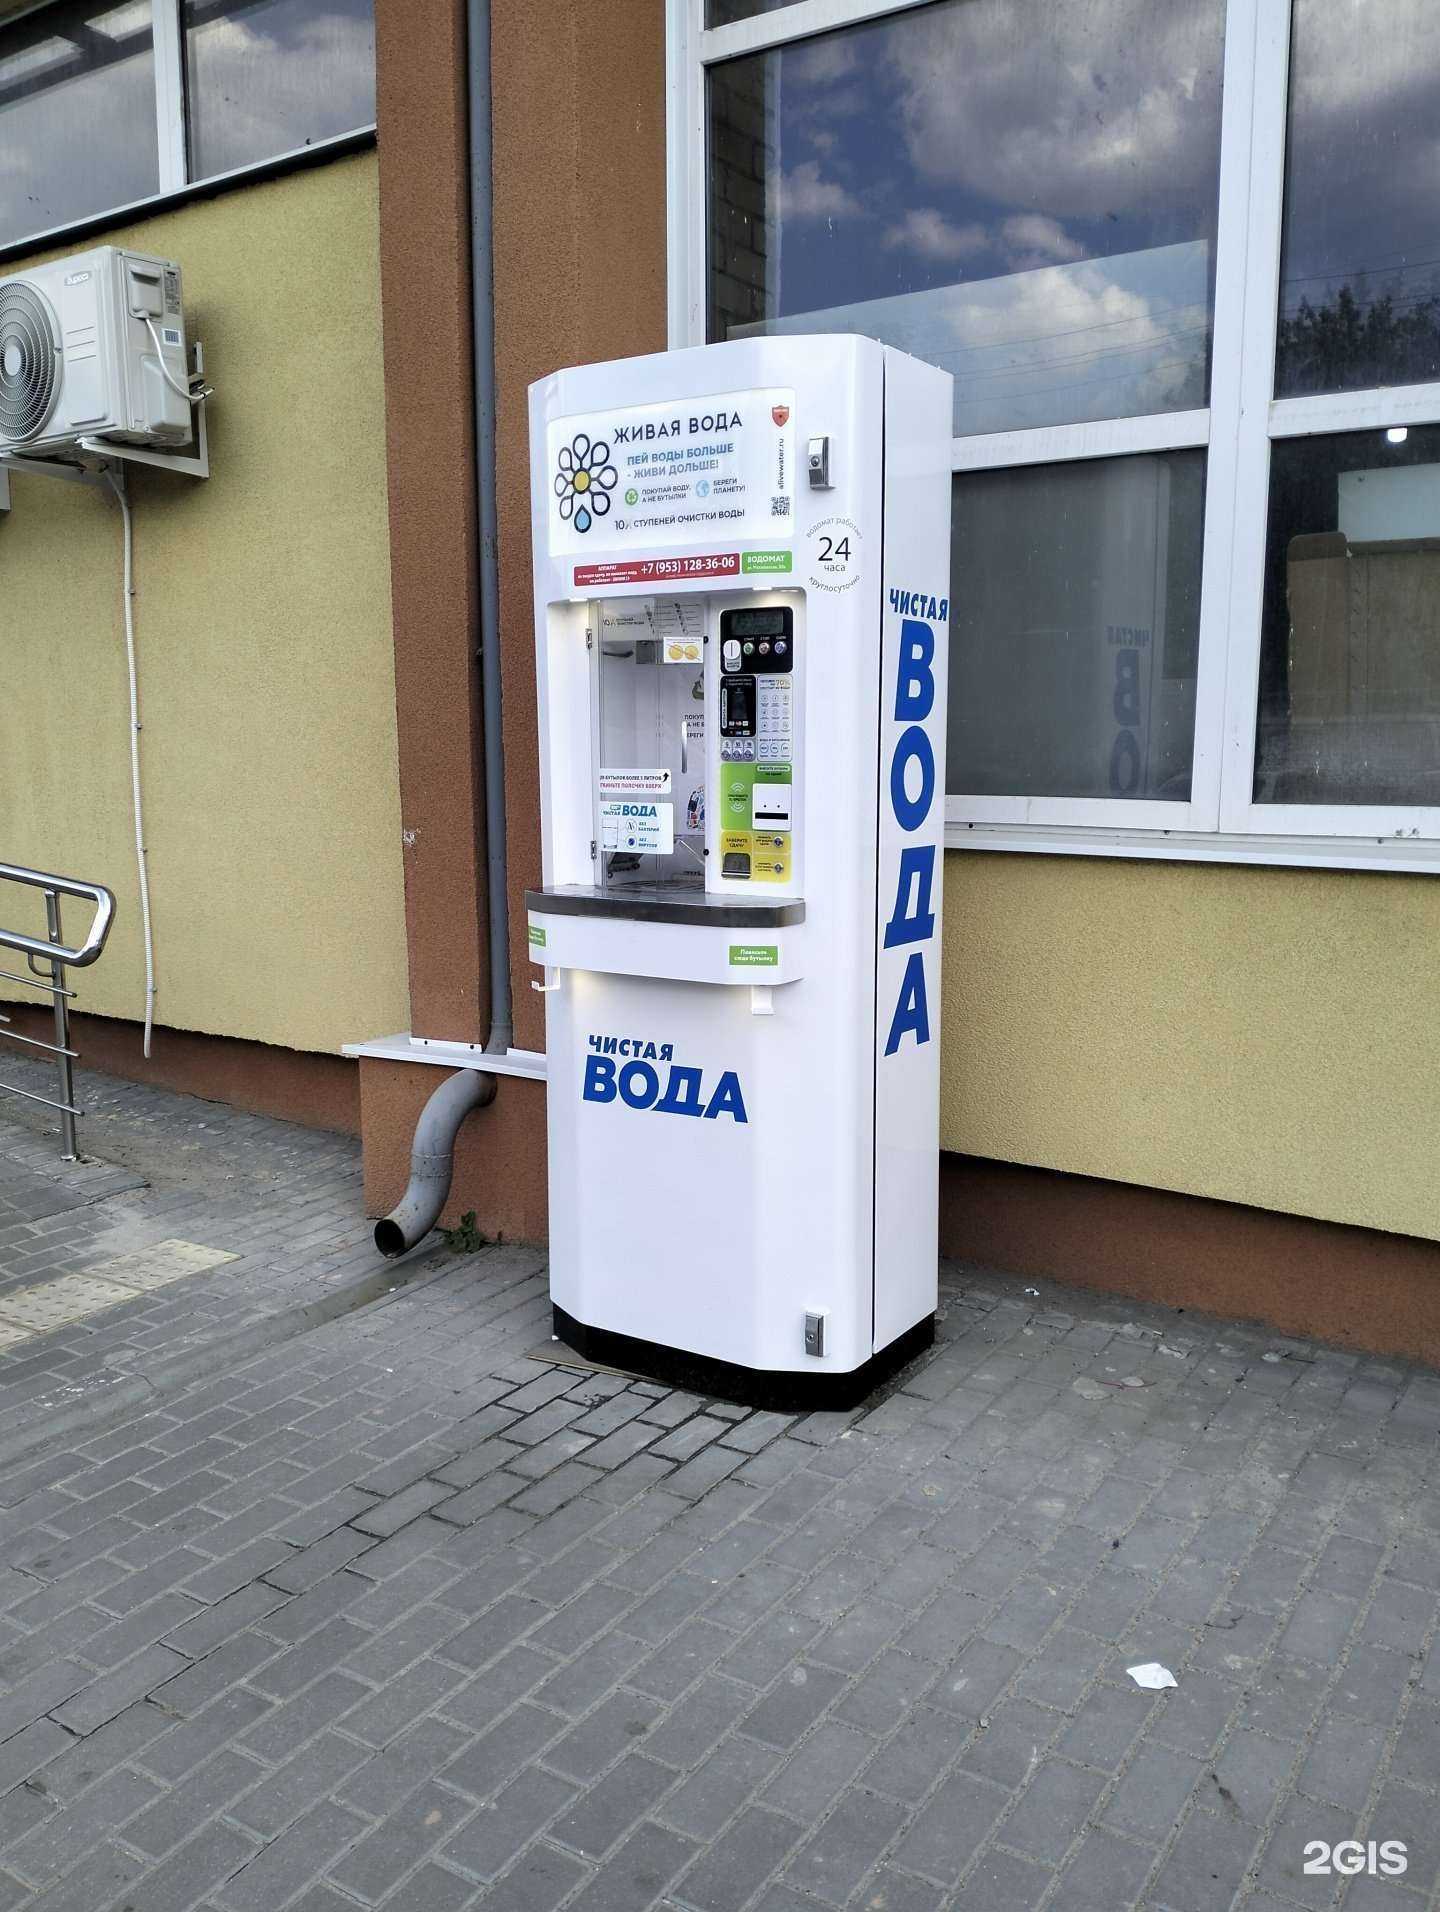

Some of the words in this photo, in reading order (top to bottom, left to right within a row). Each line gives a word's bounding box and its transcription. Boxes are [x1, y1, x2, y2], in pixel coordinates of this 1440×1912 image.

[614, 420, 681, 444] ЖИВАЯ
[689, 411, 743, 434] ВОДА
[627, 454, 649, 466] ПЕЙ
[651, 450, 684, 463] ВОДЫ
[687, 443, 735, 458] БОЛЬШЕ
[634, 467, 666, 479] ЖИВИ
[669, 459, 719, 476] ДОЛЬШЕ!
[642, 486, 672, 495] ПОКУПАЙ
[713, 478, 738, 486] БЕРЕГИ
[713, 485, 746, 494] ПЛАНЕТУ!
[648, 495, 656, 503] НЕ
[657, 493, 687, 502] БУТЫЛКИ
[633, 517, 676, 528] СТУПЕНЕЙ
[678, 511, 717, 523] ОЧИСТКИ
[719, 509, 745, 519] ВОДЫ
[818, 536, 852, 561] 24
[641, 562, 655, 575] +7
[656, 560, 681, 575] (953)
[684, 556, 735, 571] 128-36-06
[747, 555, 785, 563] ВОДОМАТ
[824, 564, 846, 572] часа
[808, 575, 861, 593] круглосуточно
[889, 588, 948, 622] ЧИСТАЯ
[622, 805, 657, 817] ВОДА
[884, 619, 936, 1057] ВОДА
[588, 1034, 674, 1061] ЧИСТАЯ
[583, 1054, 748, 1123] ВОДА
